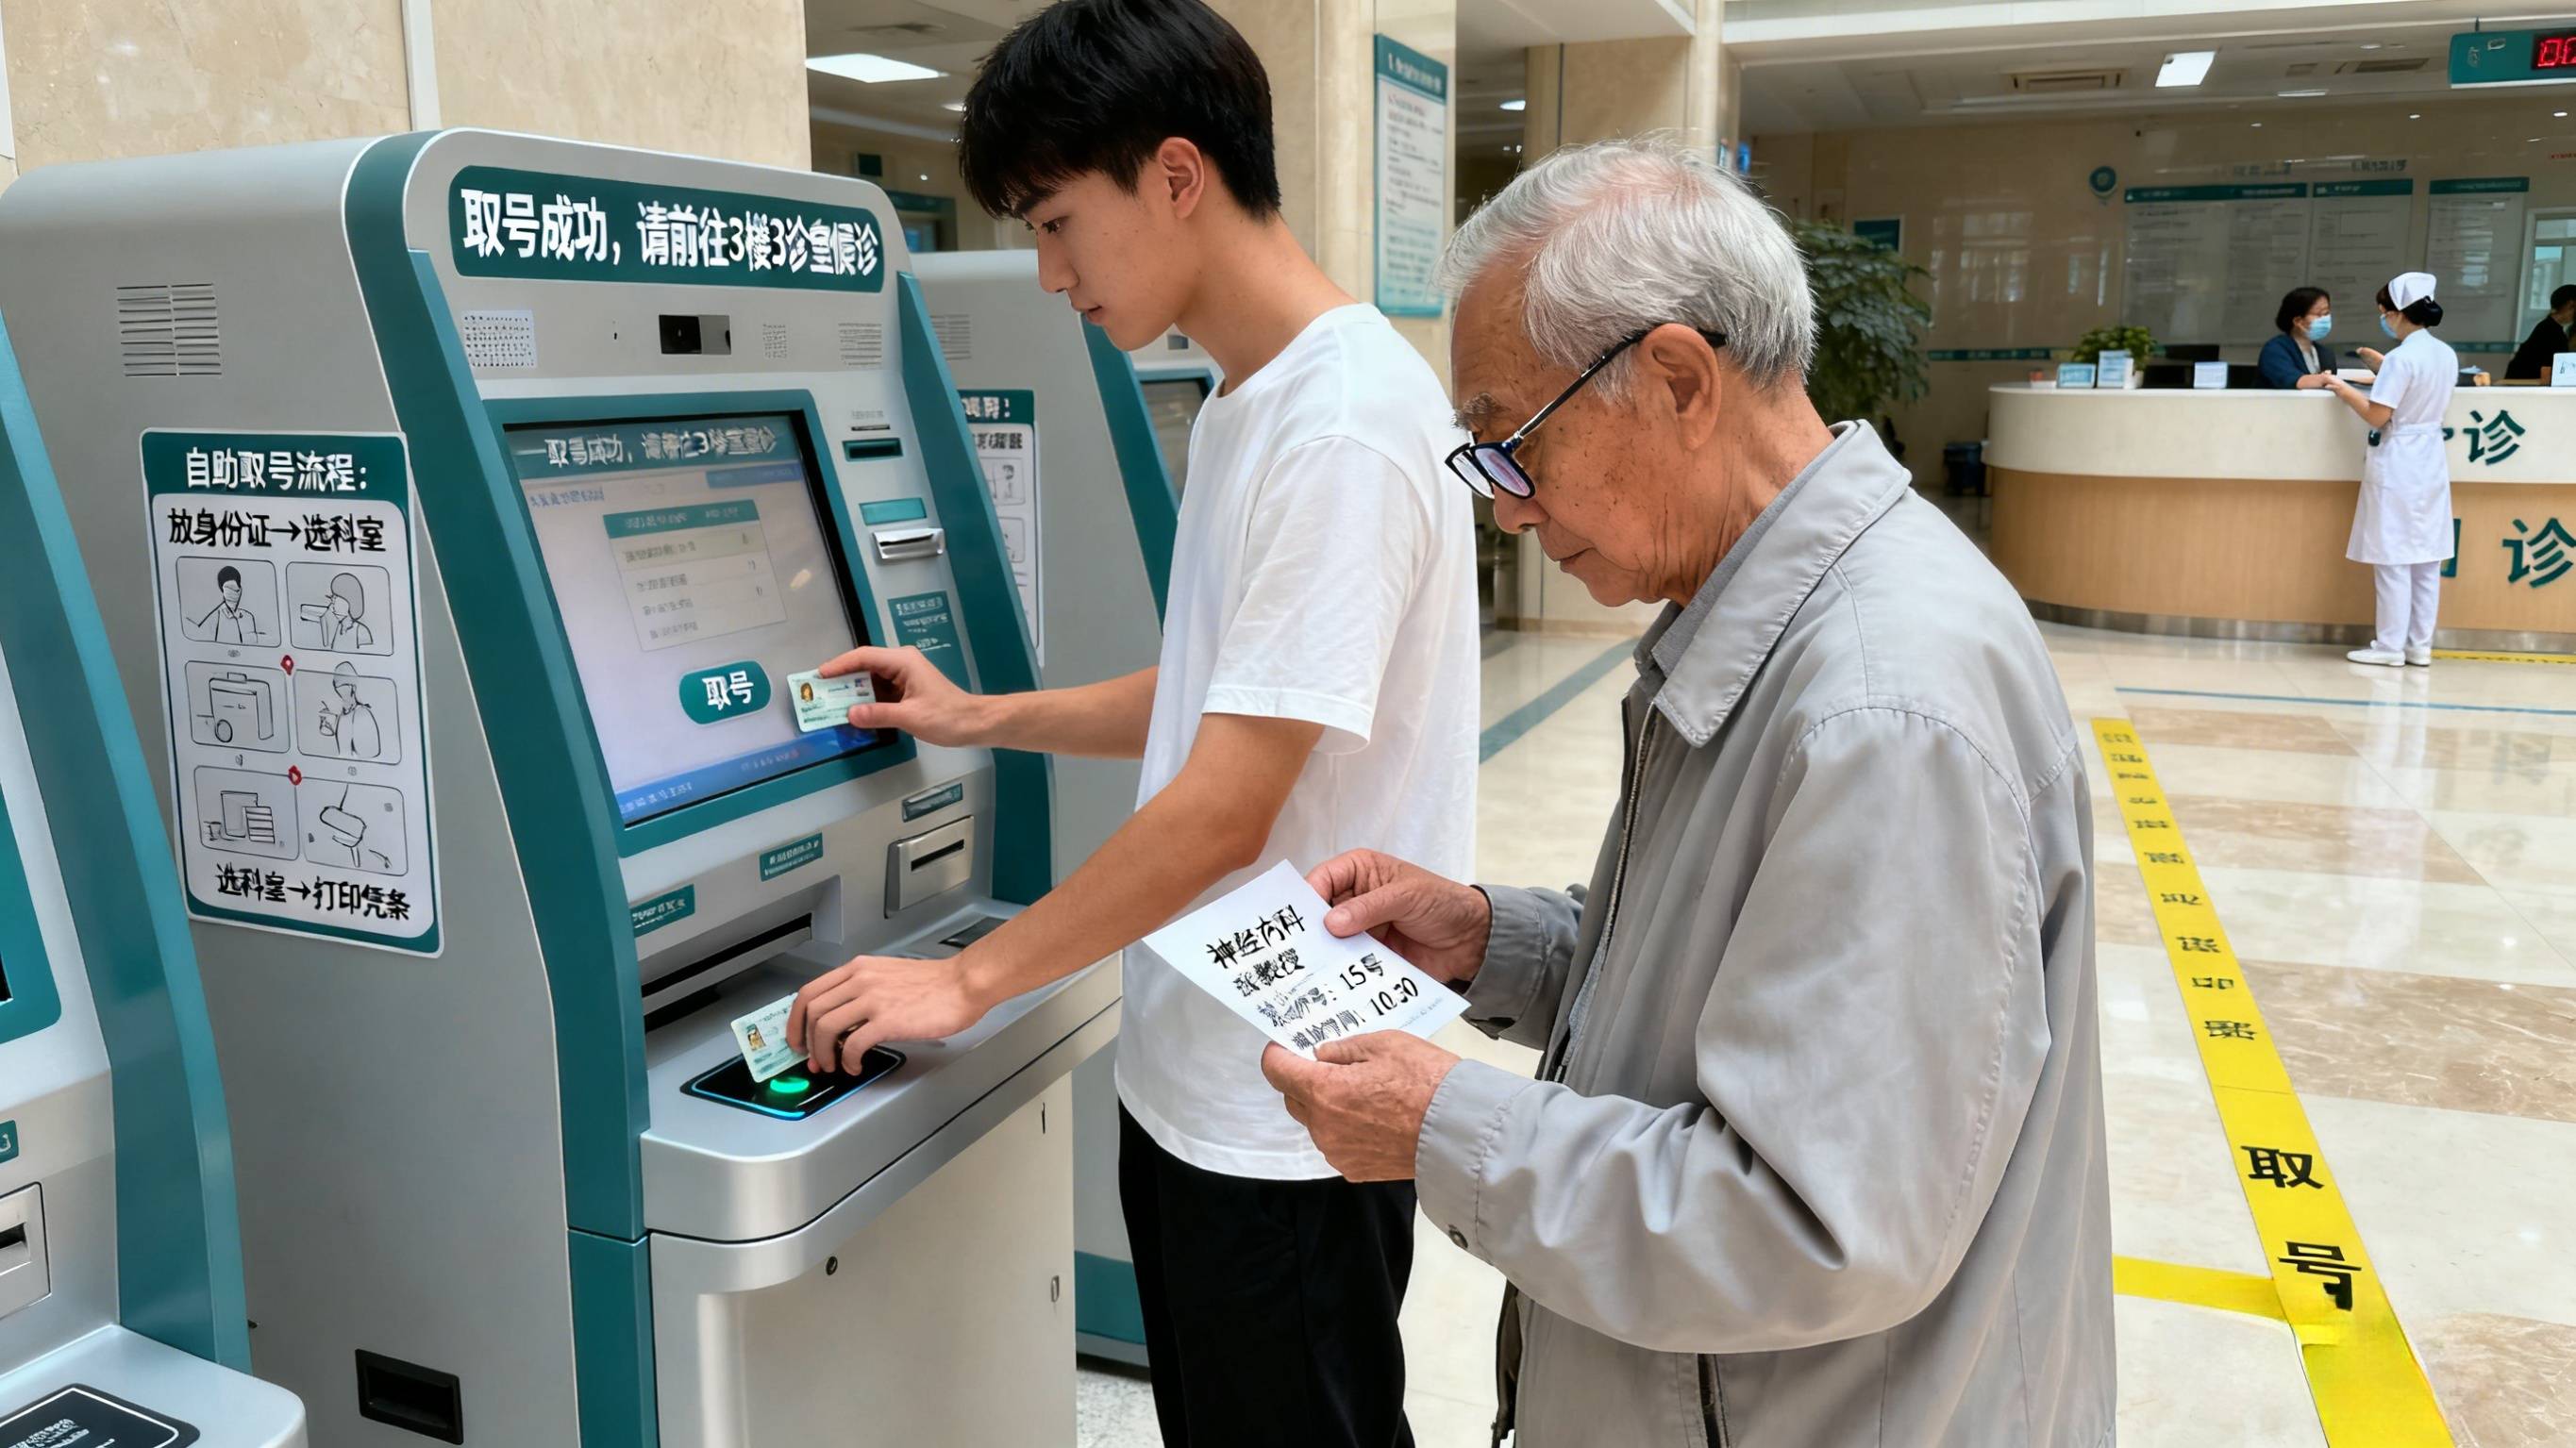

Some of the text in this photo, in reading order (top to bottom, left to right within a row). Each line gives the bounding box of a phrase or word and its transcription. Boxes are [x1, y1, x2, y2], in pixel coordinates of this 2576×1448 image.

[168, 507, 387, 554] 放身份证 选科室
[701, 671, 754, 710] 取号
[2241, 1145, 2363, 1312] 取号
